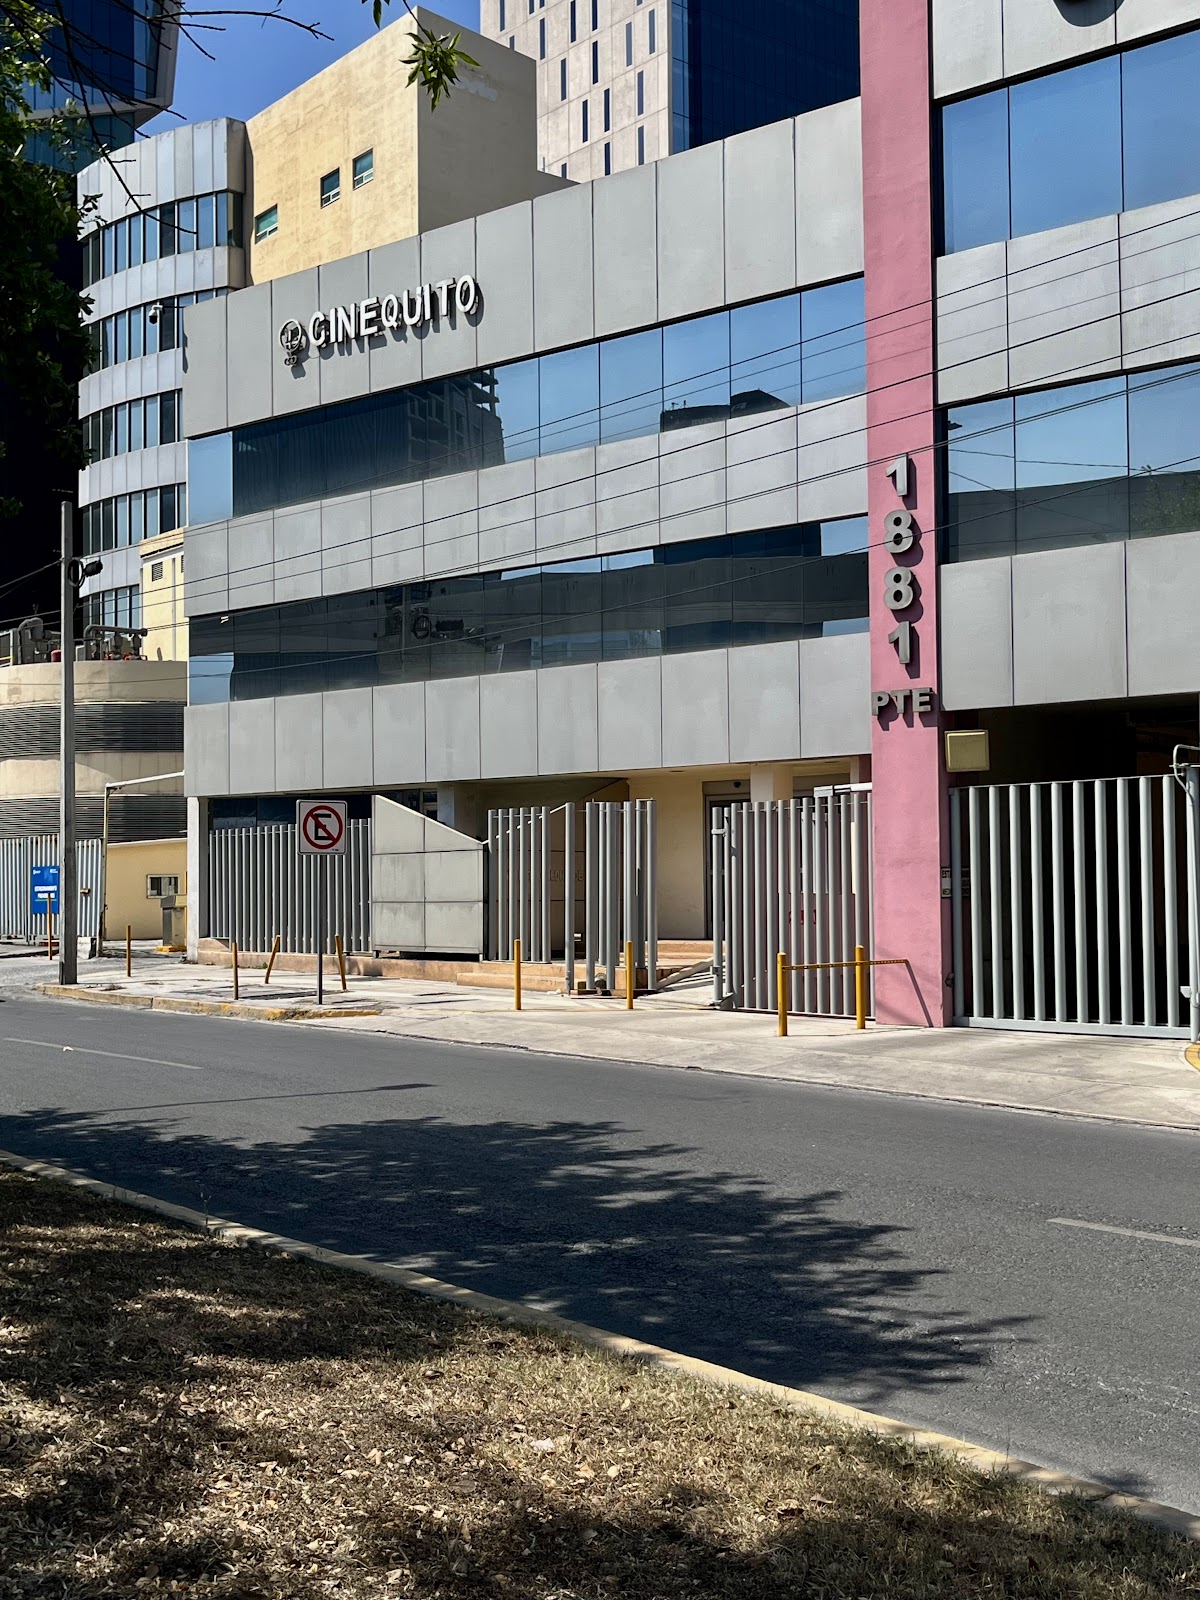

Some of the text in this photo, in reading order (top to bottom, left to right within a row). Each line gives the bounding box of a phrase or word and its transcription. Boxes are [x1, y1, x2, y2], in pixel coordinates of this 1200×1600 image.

[309, 274, 476, 347] CINEQUITO
[883, 453, 914, 664] 1881
[872, 687, 932, 716] PTE
[314, 813, 333, 840] E
